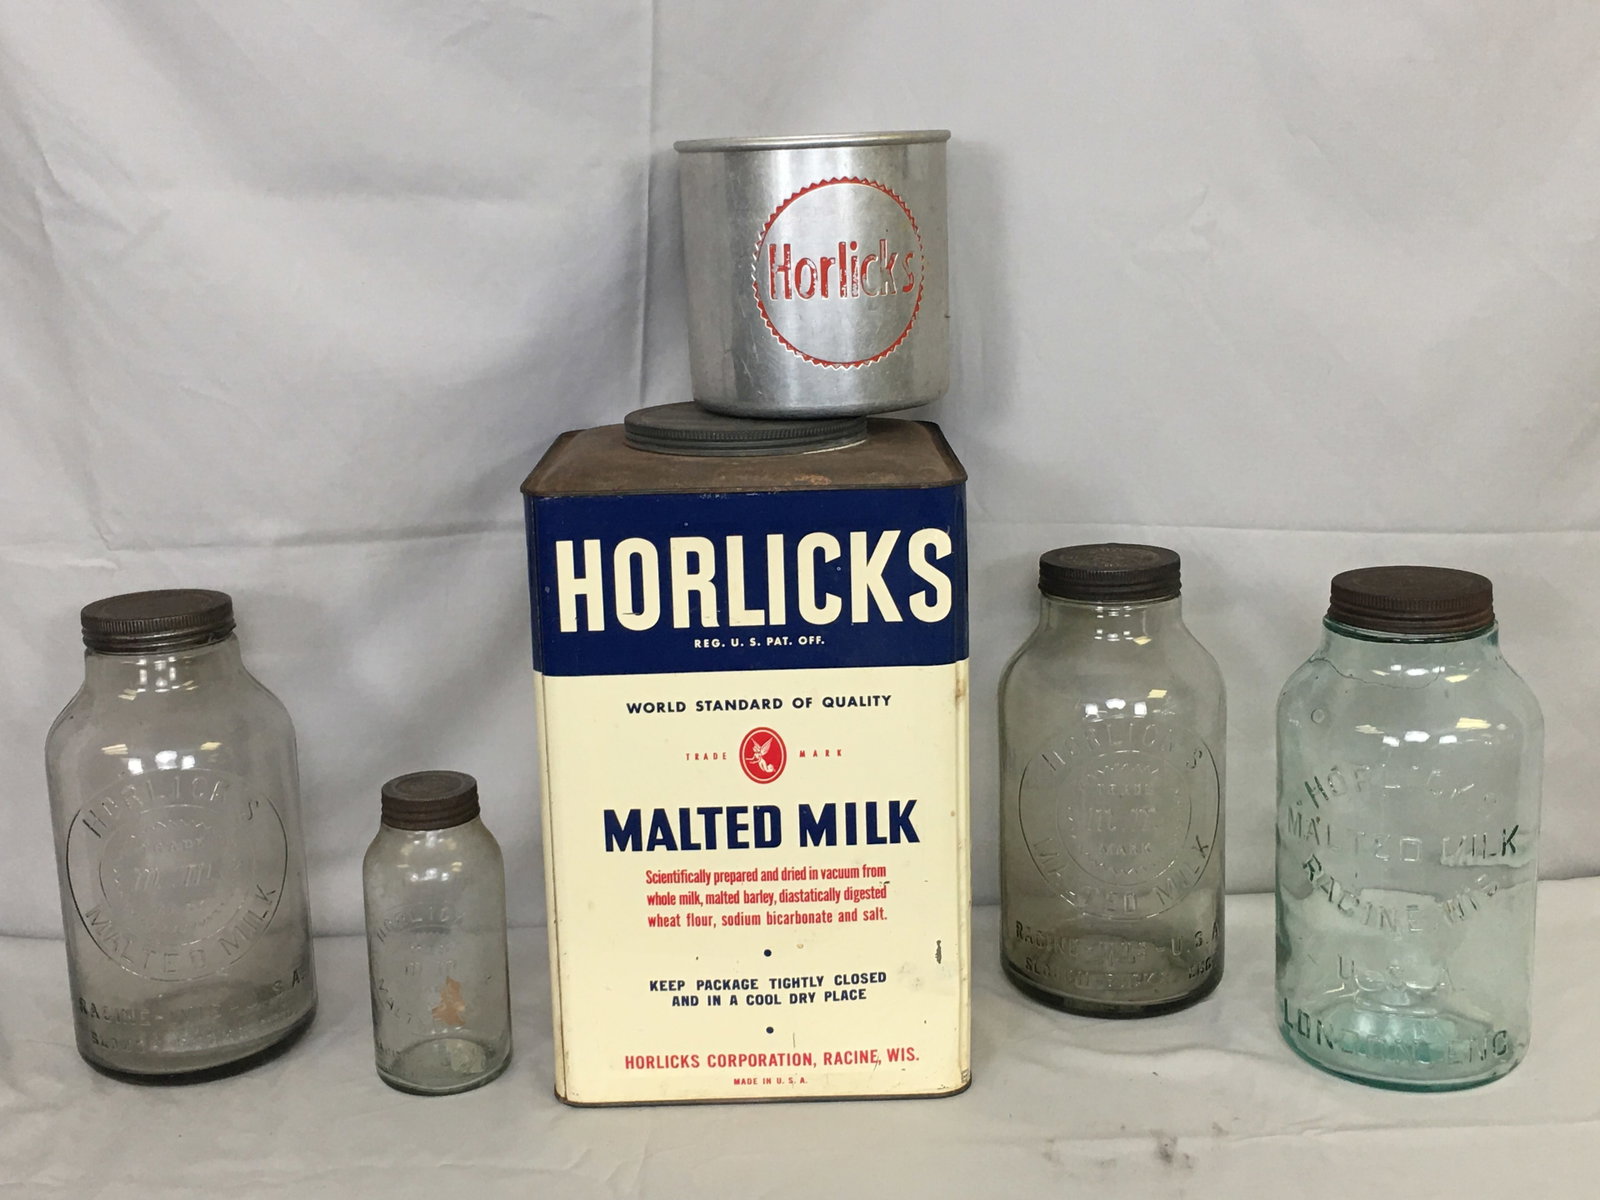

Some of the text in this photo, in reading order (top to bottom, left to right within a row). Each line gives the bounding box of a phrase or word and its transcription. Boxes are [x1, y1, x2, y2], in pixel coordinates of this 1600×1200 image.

[767, 239, 915, 300] Horlicks
[555, 527, 953, 633] HORLICKS
[694, 638, 726, 649] REG.
[766, 636, 793, 647] PAT.
[798, 635, 826, 646] OFF.
[626, 695, 893, 714] WORLD STANDARD OF QUALITY
[685, 749, 843, 761] TRADE MARK
[603, 799, 920, 852] MALTED MILK
[1441, 824, 1520, 862] MILK
[645, 864, 887, 885] Scientifically prepared and dried in vacuum from
[1152, 834, 1210, 906] MILK
[647, 884, 887, 907] whole milk, malted barley, diastatically digested
[1302, 853, 1424, 933] RACINE
[217, 883, 277, 957] MILK
[647, 907, 888, 929] wheat flour, sodium bicarbonate and salt.
[649, 971, 887, 992] KEEP PACKAGE TIGHTLY CLOSED
[672, 989, 867, 1007] AND IN A COOL DRY PLACE
[625, 1046, 920, 1070] HORLICKS CORPORATION, RACINE, WIS.
[733, 1077, 759, 1086] MADE
[762, 1077, 772, 1085] IN
